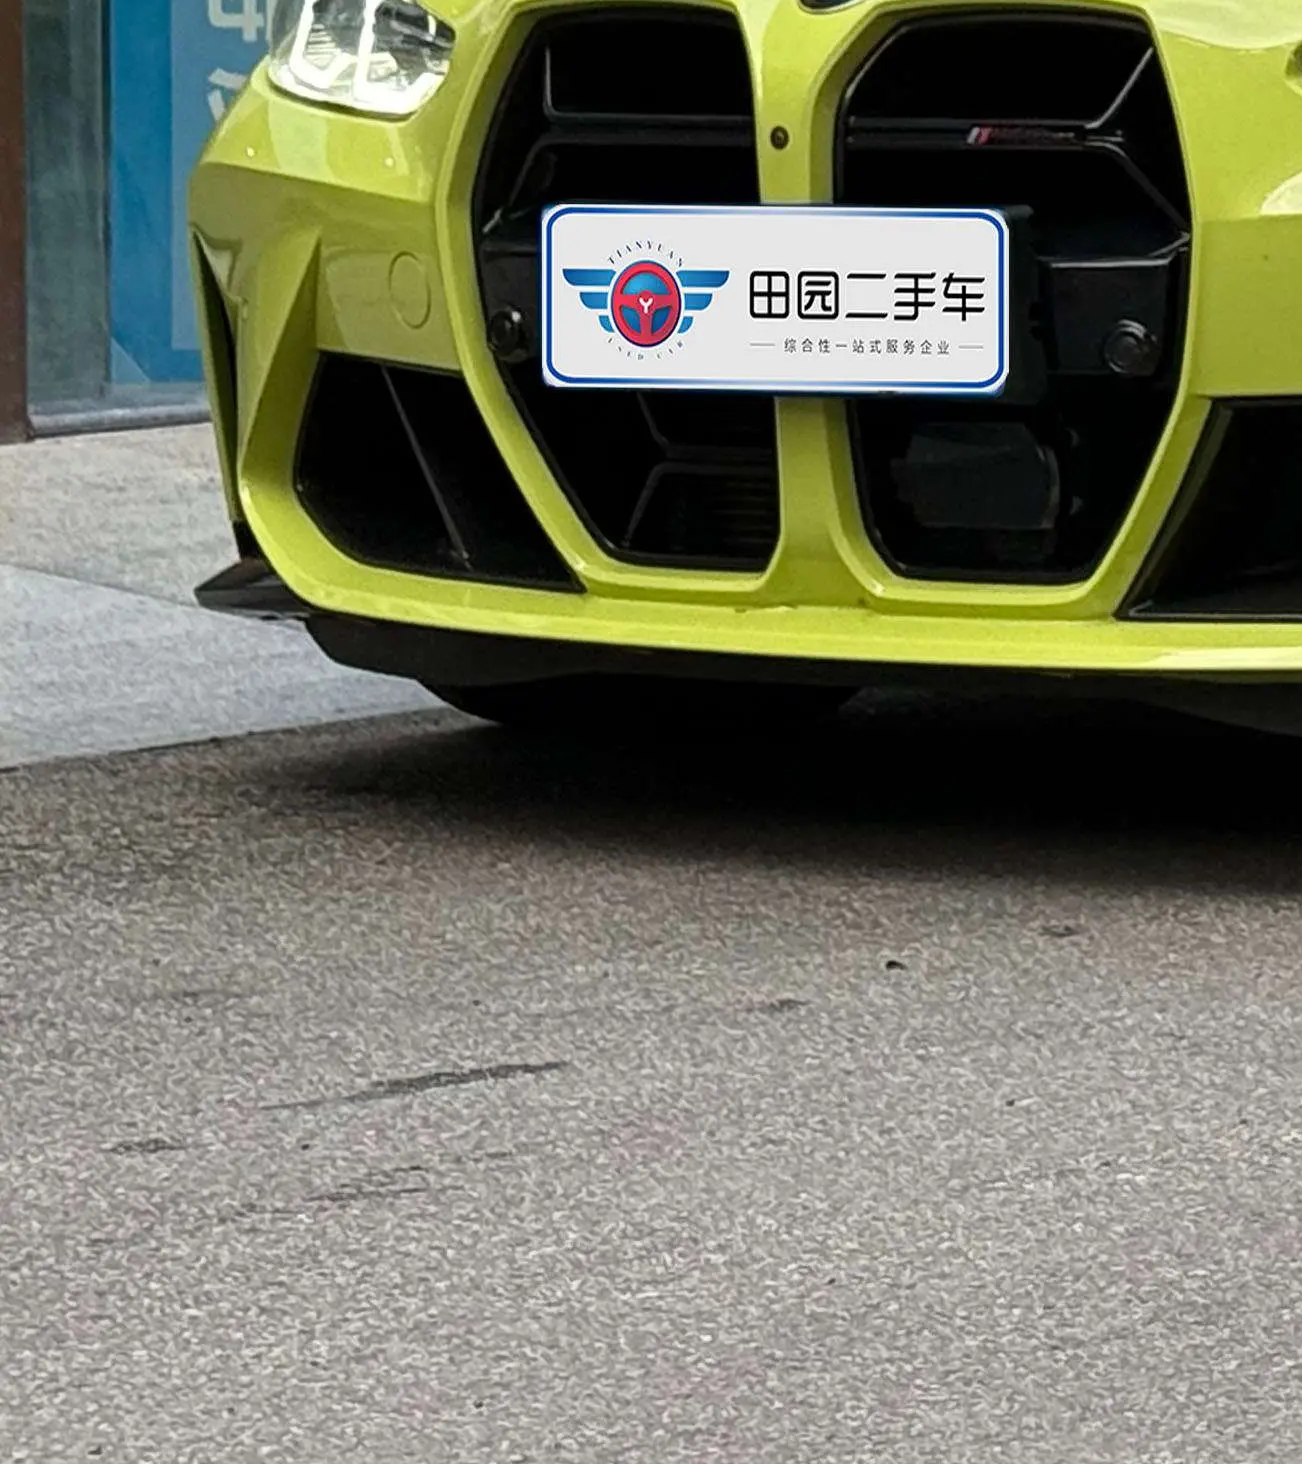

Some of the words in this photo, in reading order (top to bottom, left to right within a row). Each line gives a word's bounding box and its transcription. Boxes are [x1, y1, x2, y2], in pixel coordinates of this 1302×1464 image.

[750, 270, 986, 322] 田园二手车
[784, 338, 950, 356] 综合性一站式服务企业
